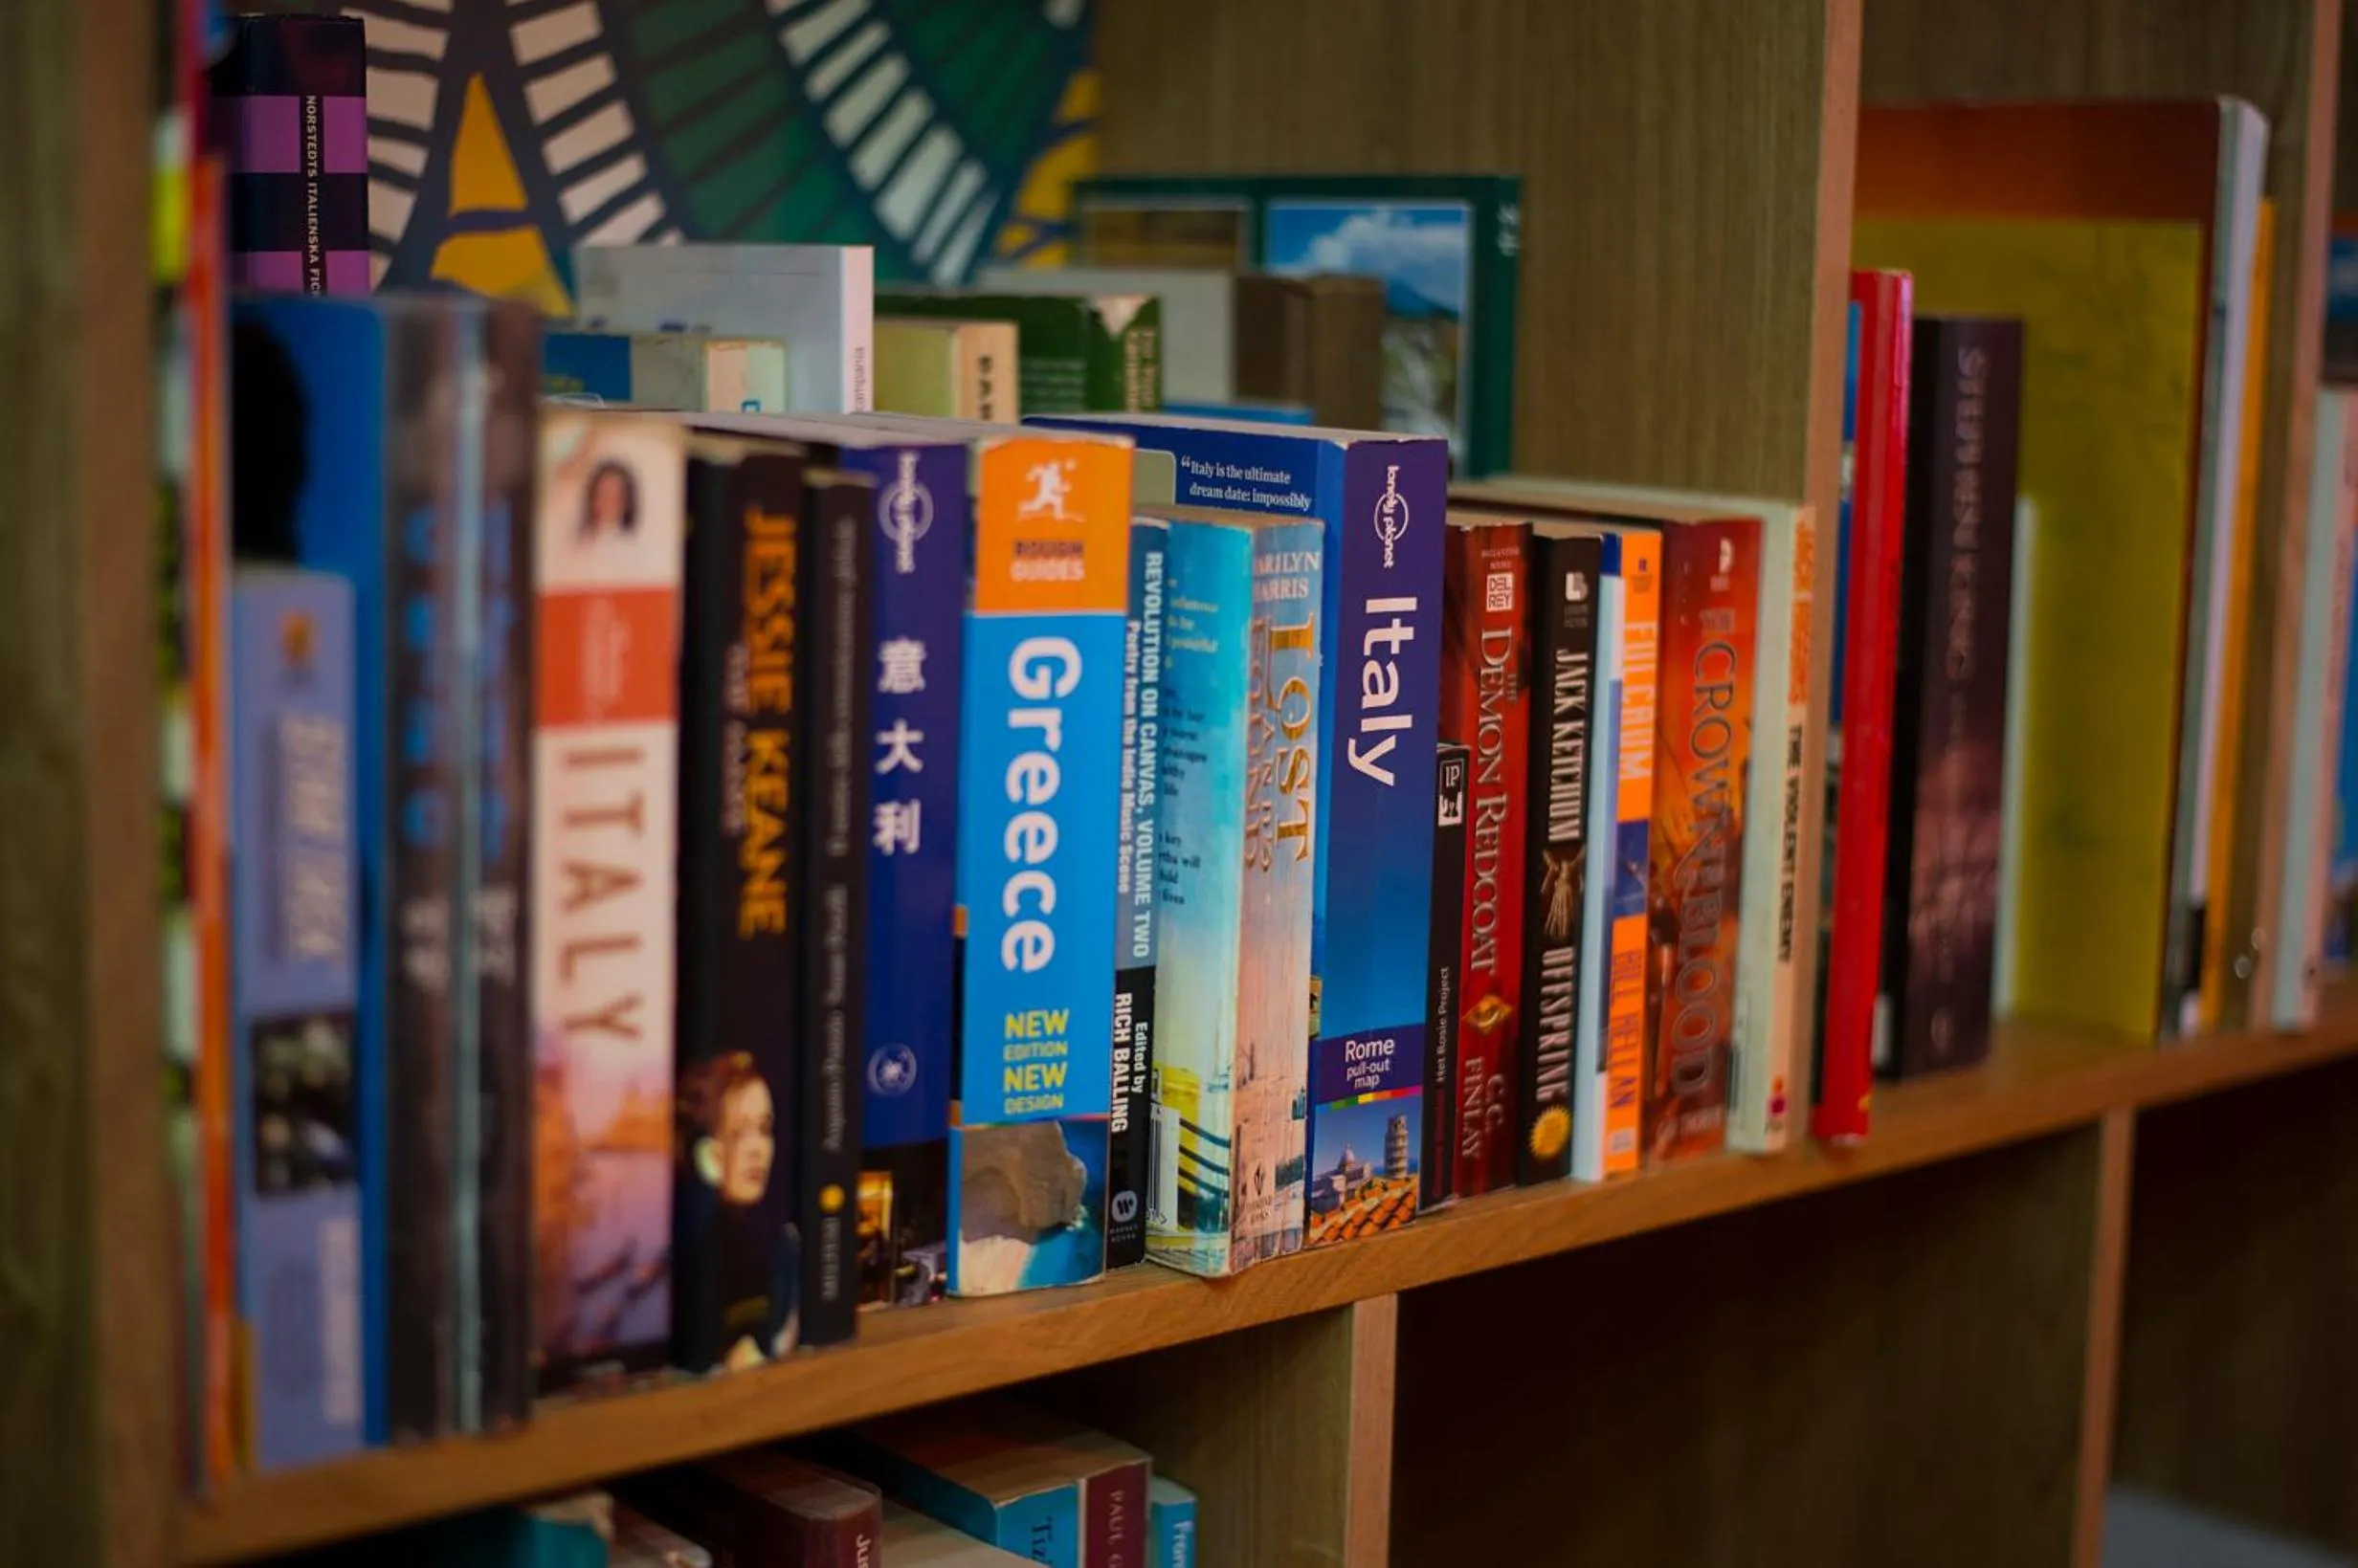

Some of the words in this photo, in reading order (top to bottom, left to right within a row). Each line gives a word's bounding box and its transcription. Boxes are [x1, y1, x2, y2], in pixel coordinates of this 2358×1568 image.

[305, 96, 319, 178] NORSTEDTS
[307, 182, 320, 264] ITALIENSKA
[309, 268, 322, 298] FIC
[1190, 481, 1223, 499] dream
[1224, 486, 1250, 502] date:
[1252, 487, 1312, 512] impossibly
[1215, 461, 1225, 478] is
[1227, 465, 1243, 479] the
[1244, 467, 1292, 485] ultimate
[1384, 465, 1400, 514] lonely
[1383, 517, 1397, 568] planet
[743, 504, 796, 715] JESSIE
[1488, 592, 1510, 608] REY
[1489, 576, 1511, 592] DEL
[1144, 552, 1163, 683] REVOLUTION
[1123, 620, 1141, 674] Poetry
[1123, 676, 1138, 716] from
[1141, 688, 1158, 718] ON
[1347, 596, 1418, 786] Italy
[1477, 627, 1513, 784] DEMON
[1553, 649, 1589, 715] JACK
[1618, 621, 1657, 779] FULCRUM
[872, 635, 927, 857] 意大利
[1123, 718, 1137, 746] the
[1267, 611, 1316, 862] LOST
[1688, 641, 1737, 866] CROWN
[1788, 724, 1804, 768] THE
[1121, 748, 1136, 790] Indie
[1137, 722, 1158, 814] CANVAS,
[1548, 720, 1586, 842] KETCHUM
[1001, 636, 1082, 973] Greece
[1119, 792, 1134, 841] Music
[1783, 776, 1800, 875] VIOLENT
[737, 729, 791, 939] KEANE
[1118, 844, 1133, 894] Scene
[1135, 818, 1154, 905] VOLUME
[1471, 792, 1509, 977] REDCOAT
[563, 744, 646, 1042] ITALY
[1133, 910, 1151, 958] TWO
[1778, 881, 1795, 963] ENEMY
[1437, 965, 1450, 1014] Project
[1675, 892, 1722, 1093] BLOOD
[1006, 1008, 1070, 1041] NEW
[1113, 992, 1132, 1043] RICH
[1436, 1017, 1448, 1054] Rosie
[1536, 946, 1574, 1101] OFFSPRING
[1004, 1041, 1069, 1062] EDITION
[1133, 1022, 1148, 1071] Edited
[1345, 1038, 1395, 1063] Rome
[1346, 1057, 1390, 1082] pull-out
[1435, 1057, 1447, 1083] Het
[1005, 1061, 1068, 1093] NEW
[1111, 1049, 1130, 1134] BALLING
[1131, 1074, 1146, 1093] by
[1354, 1072, 1381, 1091] map
[1005, 1093, 1064, 1115] DESIGN
[1461, 1056, 1483, 1159] FINLAY
[1108, 1490, 1125, 1546] PAUL
